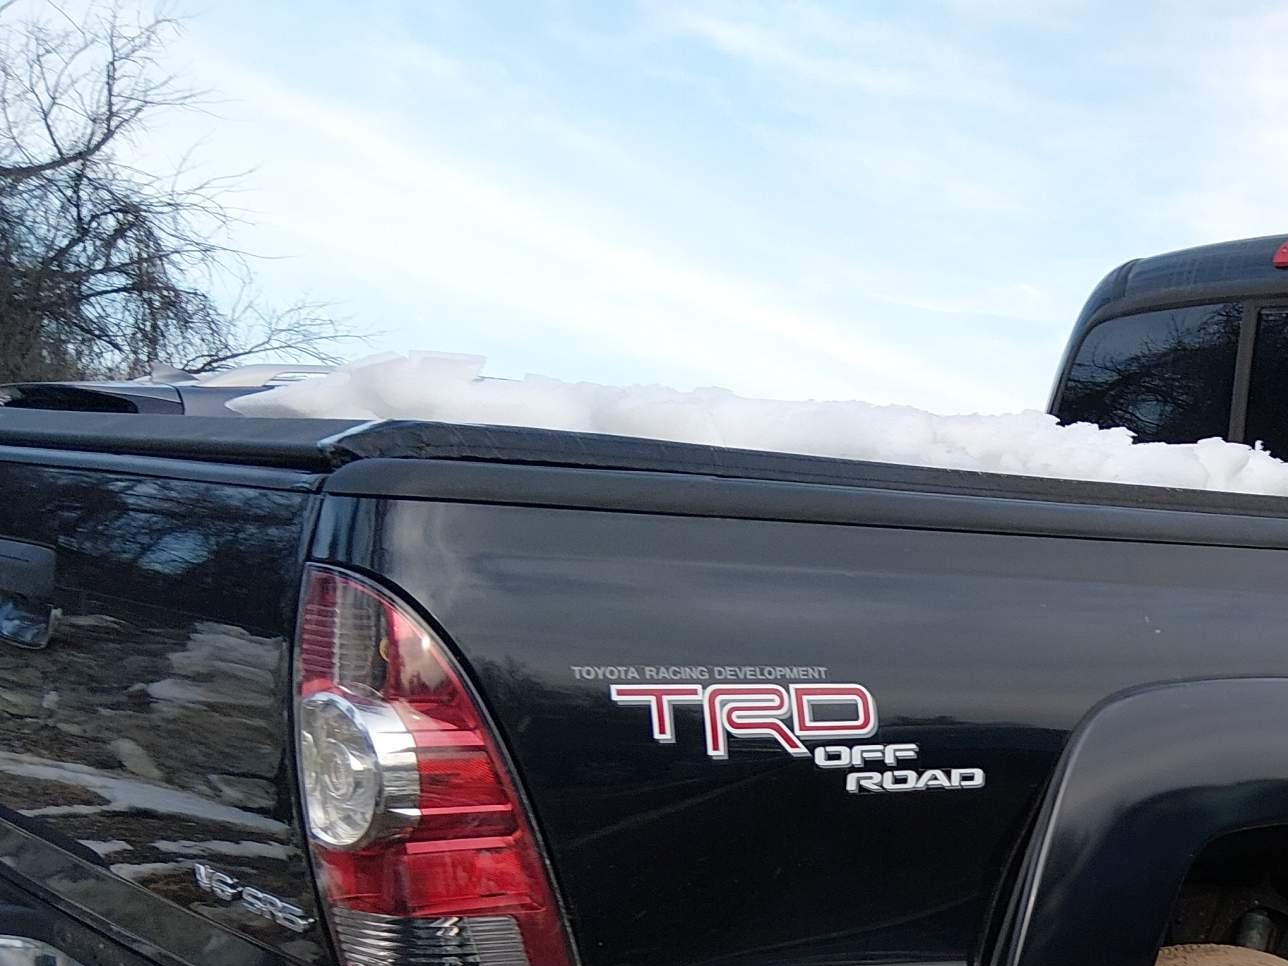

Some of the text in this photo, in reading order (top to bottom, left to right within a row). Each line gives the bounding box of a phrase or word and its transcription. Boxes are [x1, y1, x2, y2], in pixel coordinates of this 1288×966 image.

[571, 665, 828, 681] TOYOTA RACING DEVELOPMENT
[609, 683, 880, 760] TRD
[814, 743, 920, 769] OFF
[845, 767, 986, 794] ROAD
